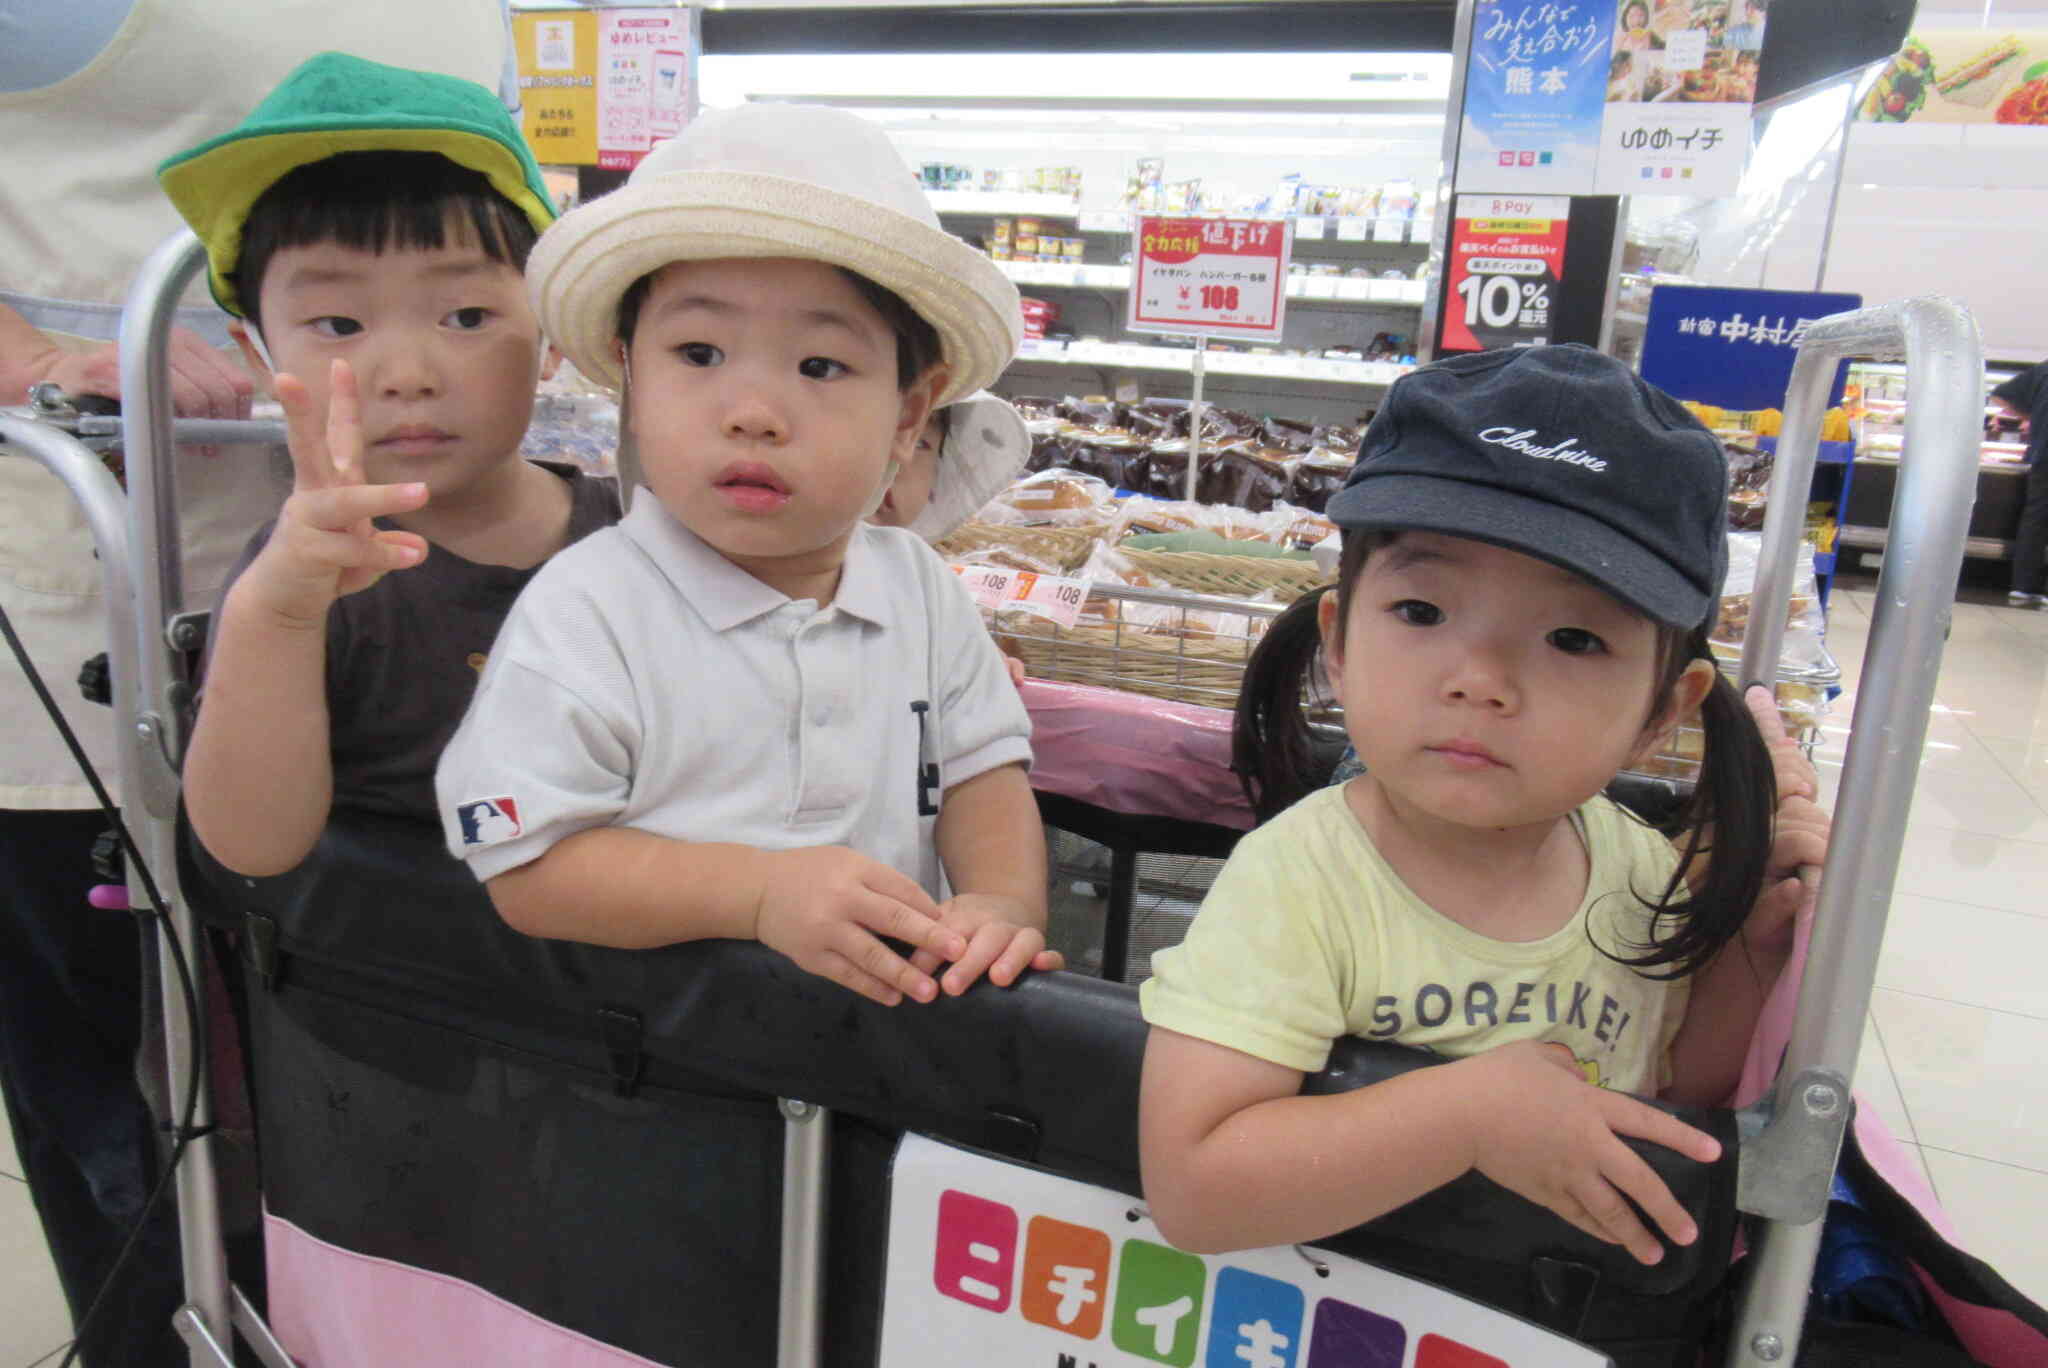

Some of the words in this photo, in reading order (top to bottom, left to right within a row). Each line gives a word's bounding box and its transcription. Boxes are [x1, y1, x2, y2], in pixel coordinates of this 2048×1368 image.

[1505, 66, 1568, 95] 熊本
[1621, 128, 1724, 149] ゆめイチ
[1505, 201, 1533, 215] Pay
[1200, 285, 1240, 311] 108
[982, 573, 1008, 590] 108
[1056, 585, 1081, 605] 108
[1368, 981, 1631, 1053] SOREIKE!
